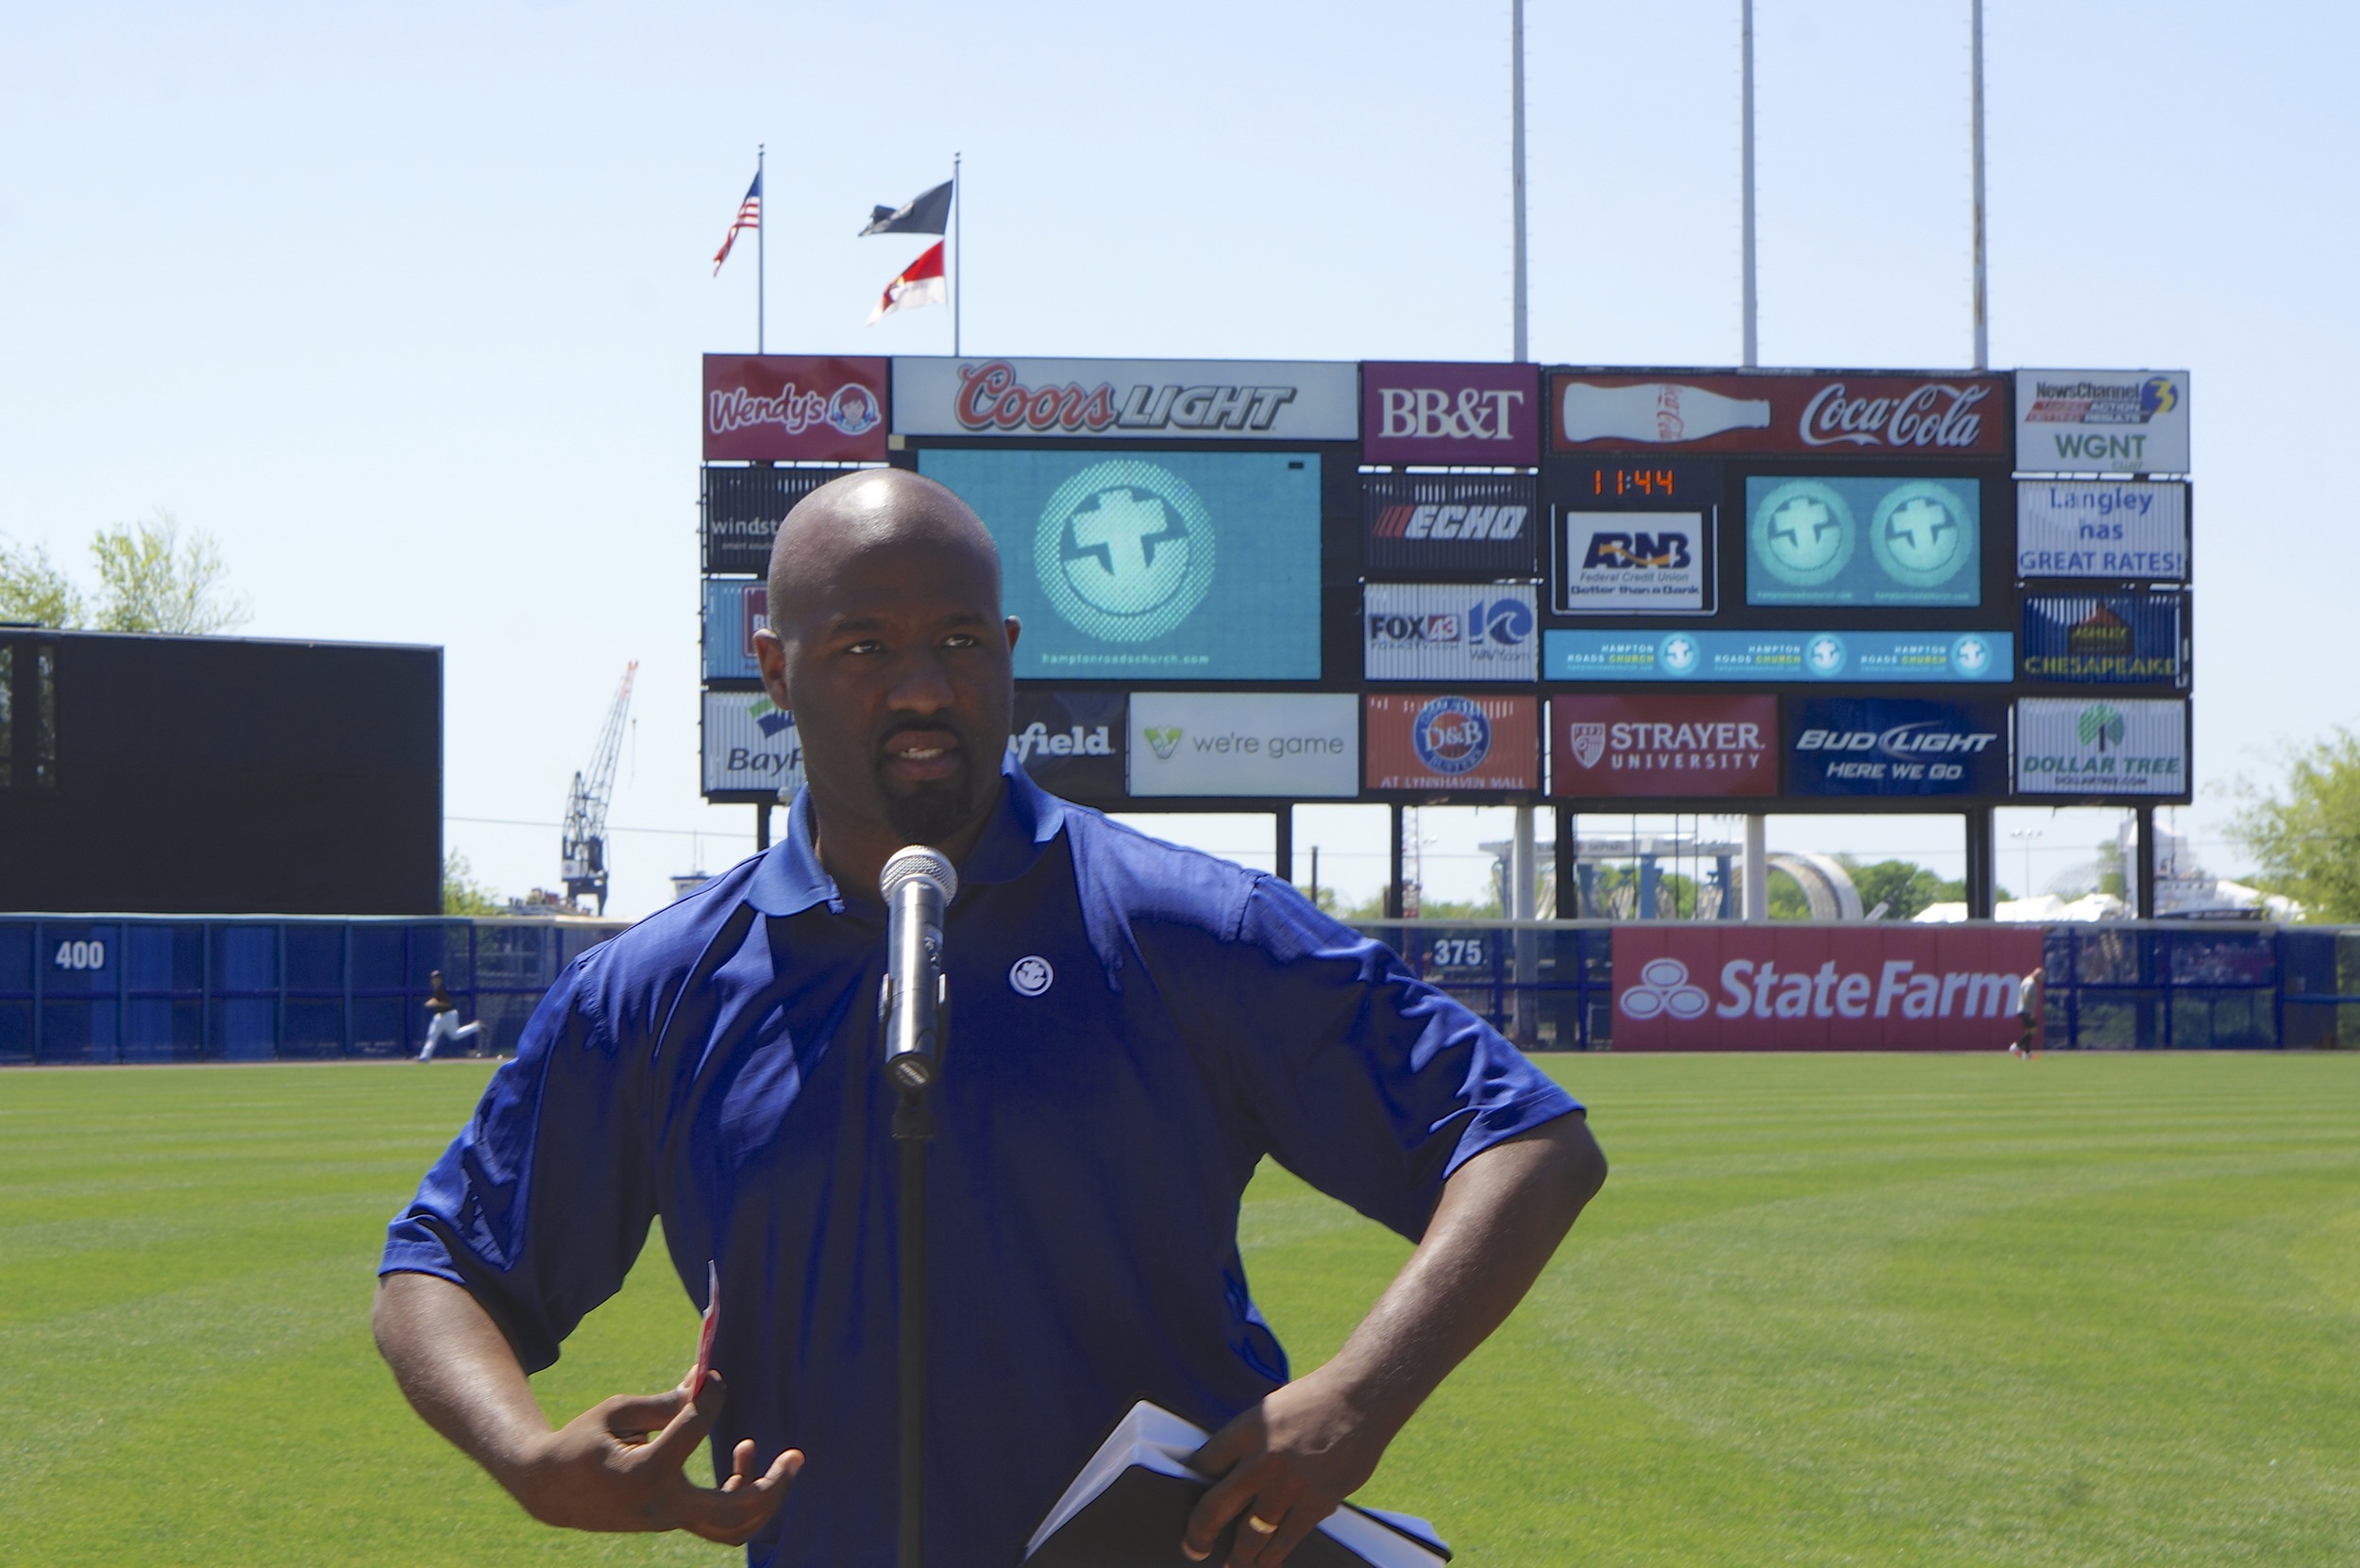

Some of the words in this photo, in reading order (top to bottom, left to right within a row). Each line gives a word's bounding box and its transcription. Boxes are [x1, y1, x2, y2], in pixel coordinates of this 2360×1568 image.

[710, 382, 827, 434] Wendy's
[956, 360, 1117, 431] Coors
[1117, 385, 1296, 430] LIGHT
[2036, 381, 2140, 398] NewsChannel
[2149, 379, 2175, 414] 3
[1377, 387, 1525, 440] BB&T
[1799, 382, 1991, 447] Coca-Cola
[2054, 433, 2147, 459] WGNT
[1593, 468, 1674, 496] 11:44
[2050, 487, 2153, 514] Langley
[1405, 505, 1528, 540] ECHO
[2018, 551, 2097, 571] GREAT
[2103, 551, 2183, 572] RATES!
[1579, 571, 1619, 582] Federal
[1622, 571, 1654, 582] Credit
[1657, 571, 1689, 582] Union
[1370, 615, 1425, 639] FOX
[1427, 615, 1459, 642] 43
[1567, 653, 1605, 663] ROADS
[1601, 643, 1655, 653] HAMPTON
[1748, 644, 1801, 654] HAMPTON
[2024, 655, 2176, 676] CHESAPEAKE
[1192, 732, 1260, 754] we're
[1268, 736, 1345, 758] game
[1420, 720, 1483, 752] D&B
[1610, 722, 1761, 750] STRAYER
[1795, 728, 1878, 750] BUD
[1891, 731, 1998, 753] LIGHT
[1610, 753, 1762, 770] UNIVERSITY
[1826, 761, 1887, 779] HERE
[1891, 763, 1925, 781] WE
[1928, 763, 1964, 781] GO
[2023, 756, 2116, 773] DOLLAR
[2123, 757, 2181, 774] TREE
[1380, 776, 1400, 789] AT
[1404, 776, 1486, 789] LYNNHAVEN
[1490, 777, 1525, 789] MALL
[55, 940, 105, 969] 400
[1434, 938, 1482, 965] 375
